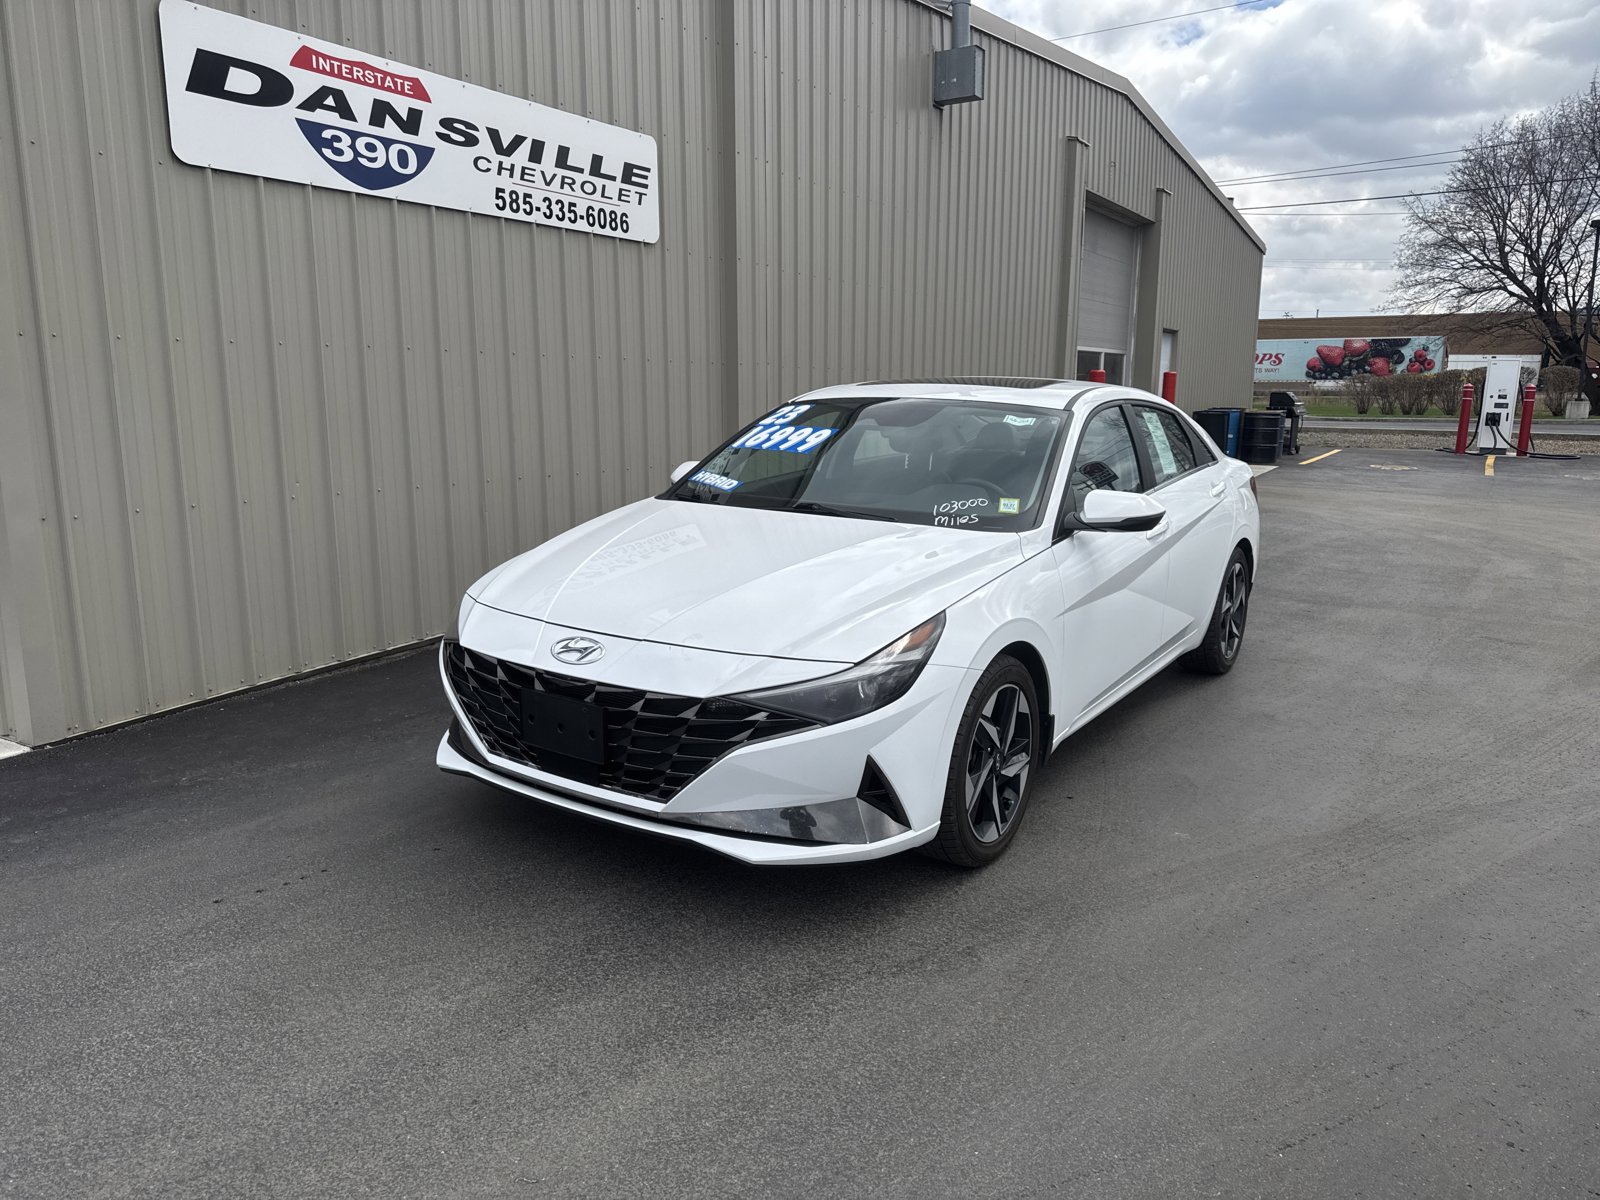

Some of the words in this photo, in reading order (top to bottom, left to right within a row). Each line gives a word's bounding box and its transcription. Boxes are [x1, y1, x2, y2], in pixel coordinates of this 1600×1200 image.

[311, 54, 414, 95] INTERSTATE
[185, 47, 652, 190] DANSVILLE
[321, 128, 418, 175] 390
[472, 155, 648, 206] CHEVROLET
[494, 187, 630, 234] 585-335-6086
[758, 404, 811, 426] 23
[731, 424, 832, 453] 16999
[691, 470, 739, 491] HYBRID
[933, 498, 989, 517] 103000
